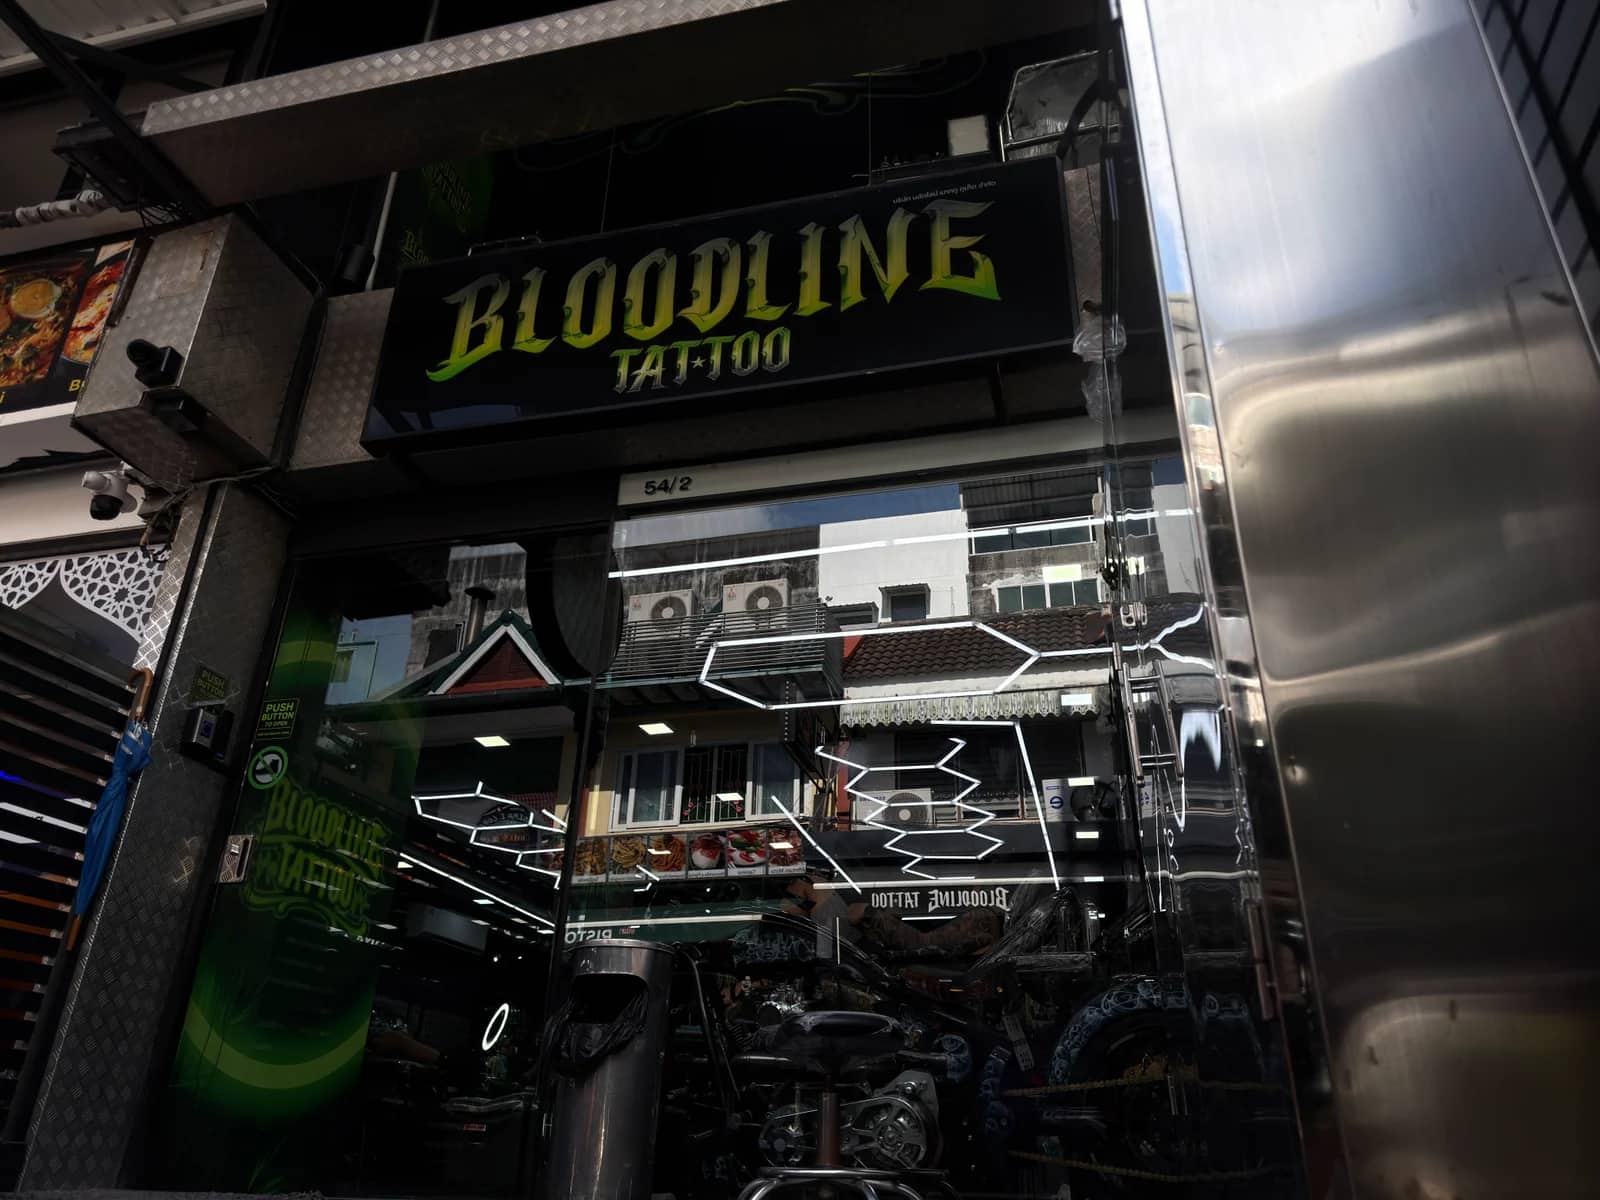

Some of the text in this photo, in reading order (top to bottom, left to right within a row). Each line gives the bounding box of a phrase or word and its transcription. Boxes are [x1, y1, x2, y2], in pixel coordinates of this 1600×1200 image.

[425, 200, 1001, 383] BLOODLINE
[609, 326, 792, 394] TATTOO
[645, 476, 692, 495] 54/2
[261, 711, 295, 721] BUTTON
[266, 702, 295, 712] PUSH
[266, 777, 386, 879] BLOODLINE
